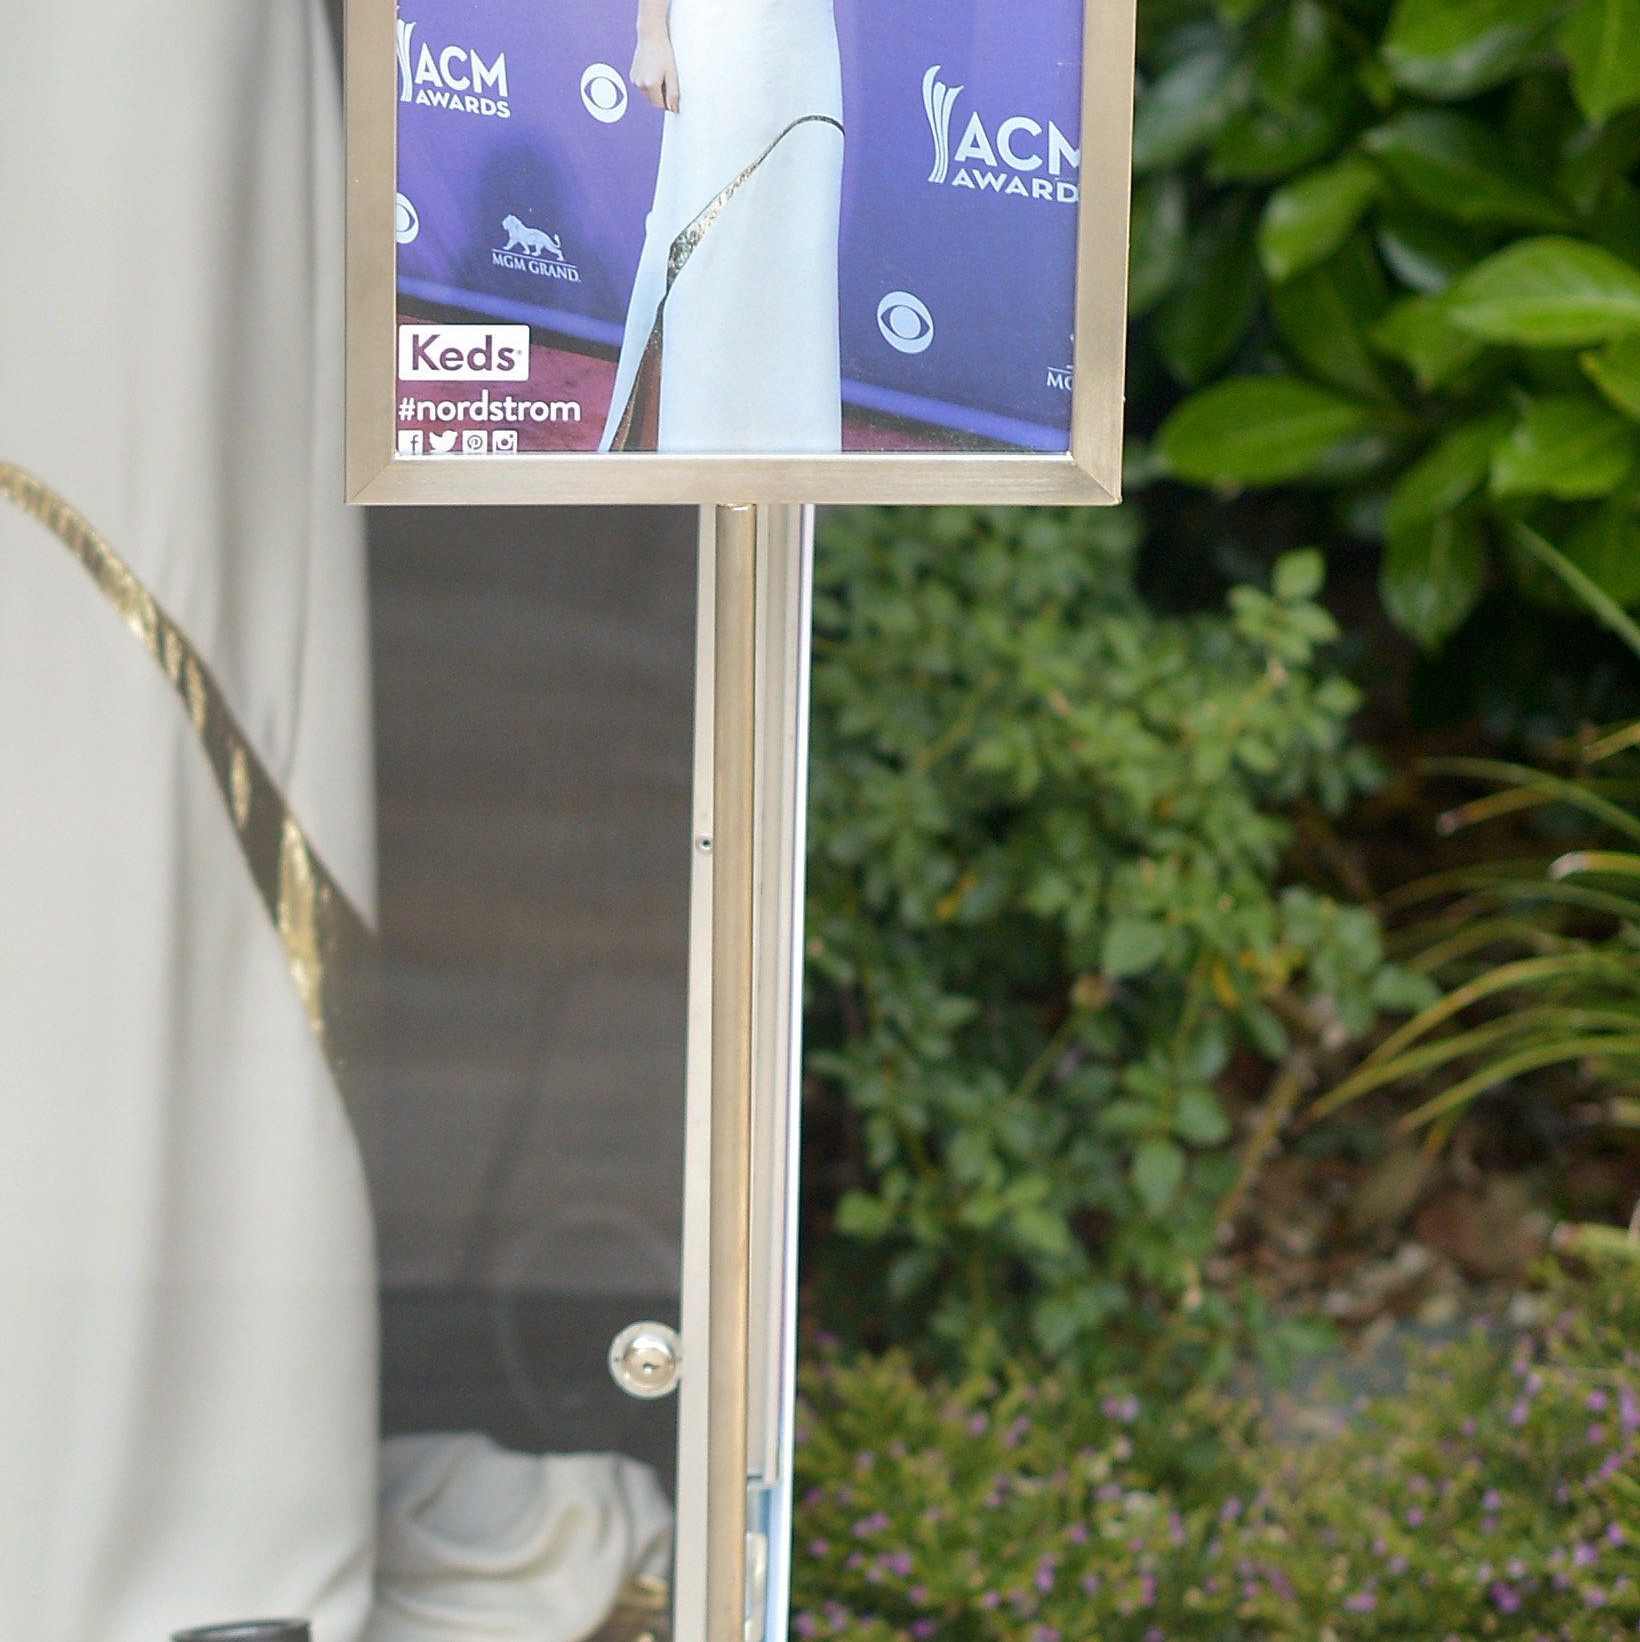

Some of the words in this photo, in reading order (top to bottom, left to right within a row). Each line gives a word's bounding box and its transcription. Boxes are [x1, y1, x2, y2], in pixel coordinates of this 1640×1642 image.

[415, 42, 508, 97] ACM
[415, 89, 511, 118] AWARDS
[952, 168, 1079, 203] AWARD
[492, 252, 526, 271] MGM
[529, 260, 579, 282] GRAND
[412, 334, 515, 371] Keds
[398, 389, 581, 421] #nordstrom
